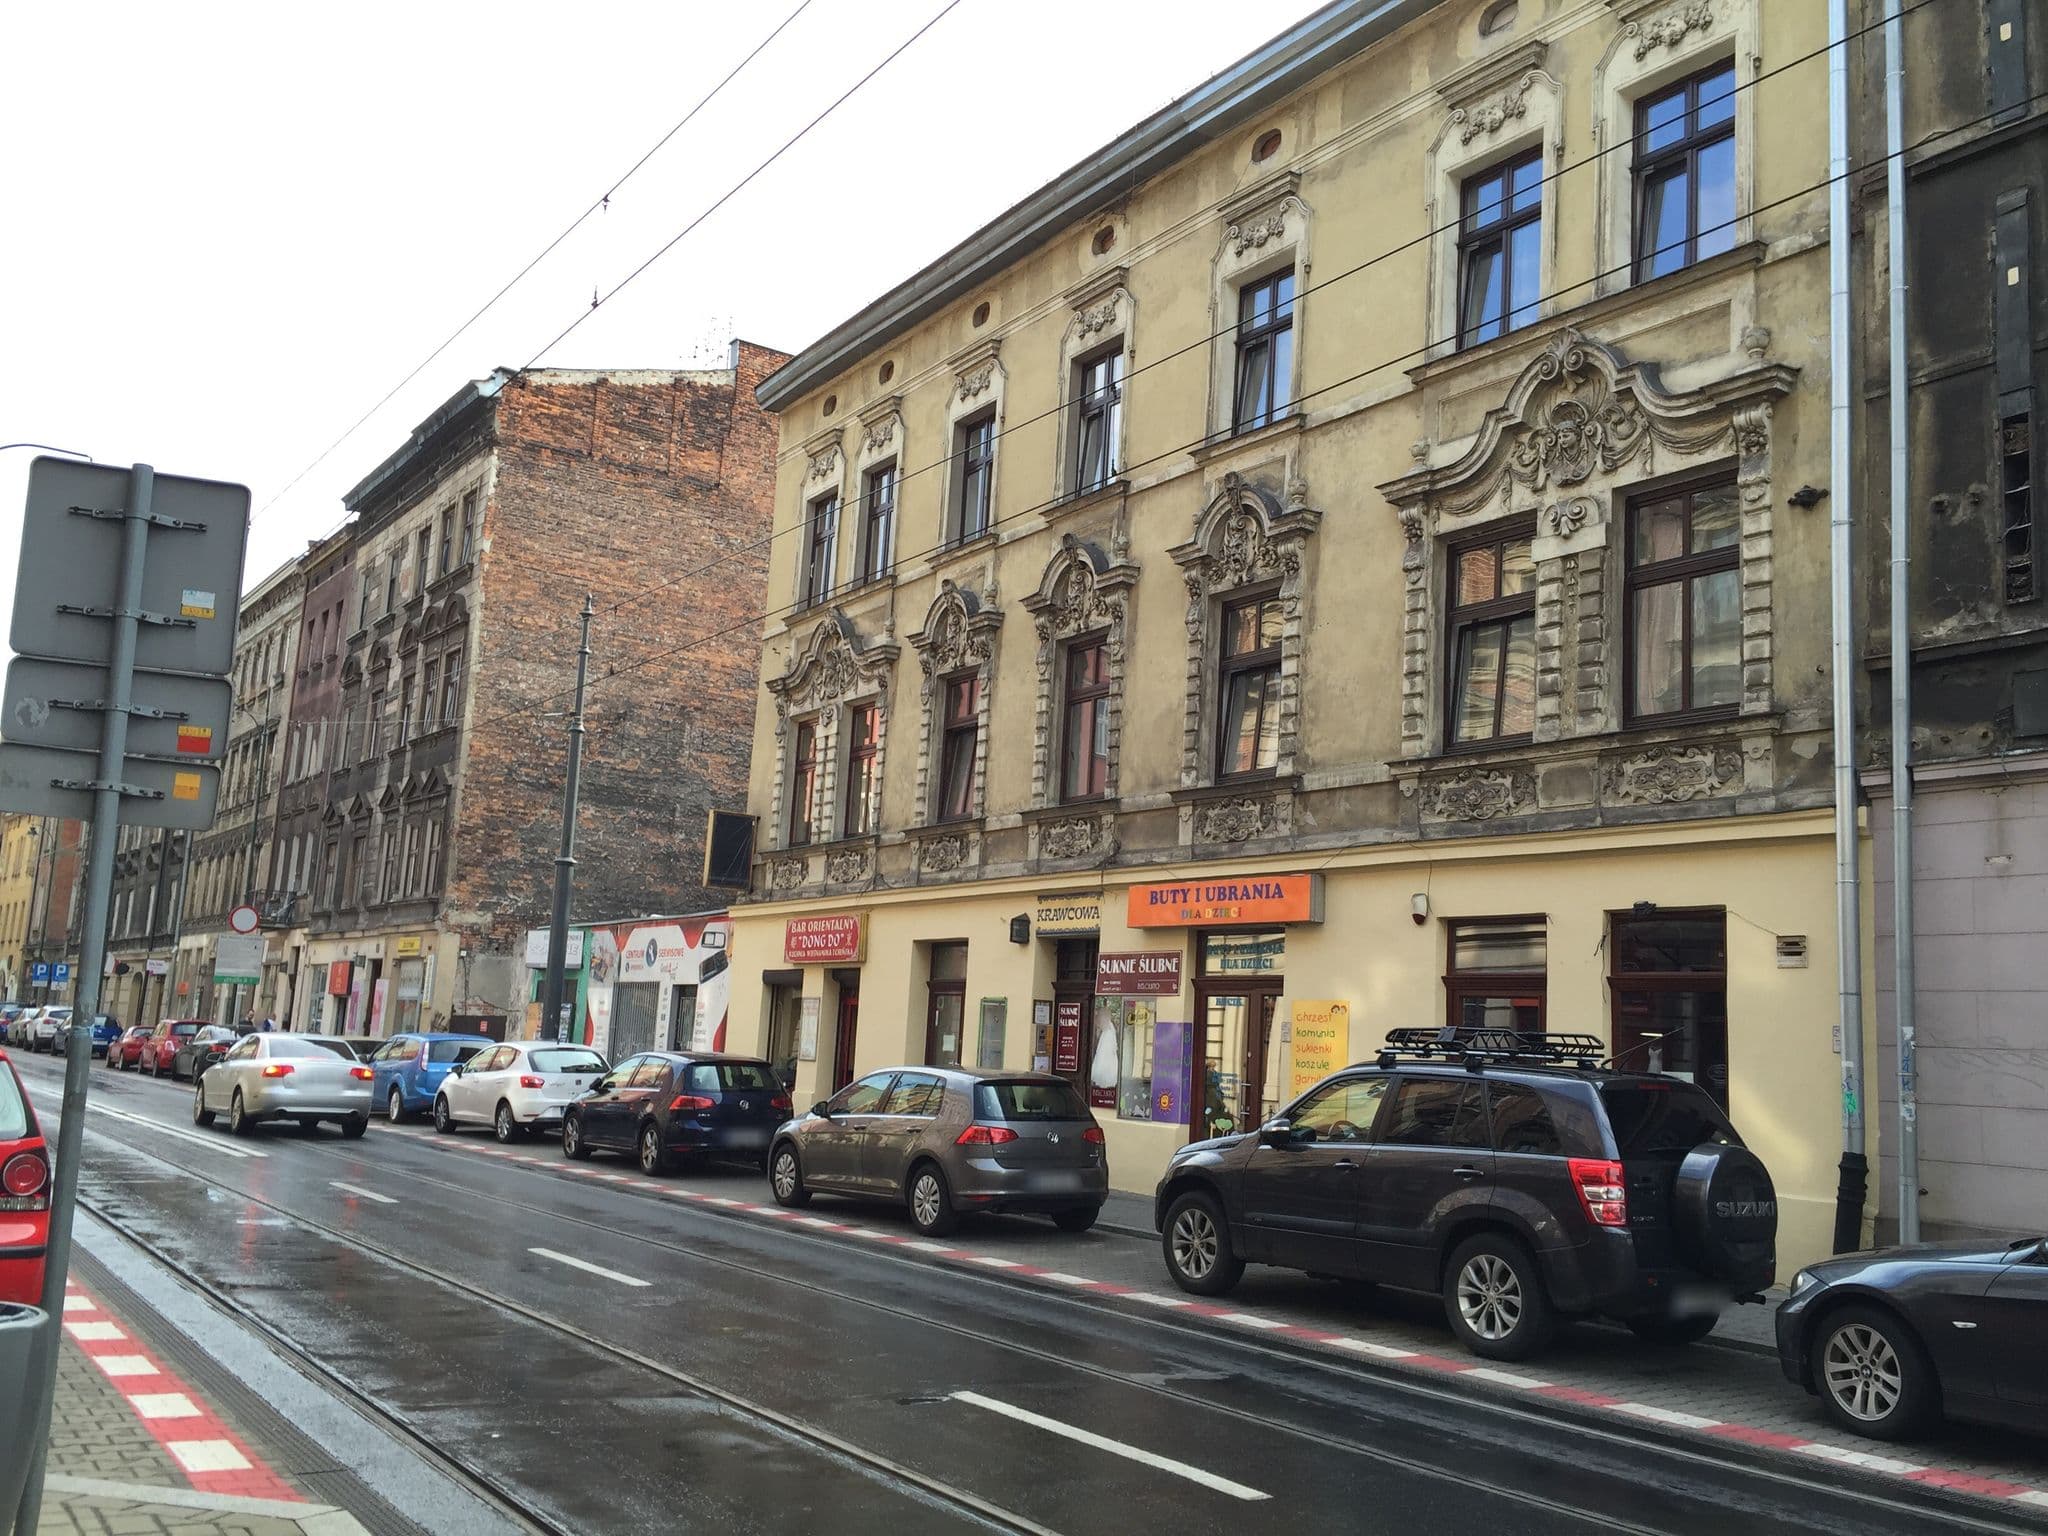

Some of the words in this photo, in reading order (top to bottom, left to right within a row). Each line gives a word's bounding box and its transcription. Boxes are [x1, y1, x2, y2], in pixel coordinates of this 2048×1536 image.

[1150, 888, 1191, 905] BUTY
[1195, 888, 1200, 902] I
[1205, 883, 1284, 901] UBRANIA
[1037, 906, 1100, 921] KRAWCOWA
[1181, 909, 1201, 919] DLA
[1205, 907, 1242, 919] DZIECI
[791, 921, 807, 933] BAR
[808, 918, 854, 932] ORIENTALNY
[1100, 959, 1136, 973] SUKNIE
[1138, 955, 1179, 973] ŚLUBNE
[37, 965, 46, 976] P
[56, 965, 66, 977] P
[1296, 1027, 1336, 1038] komunia
[1296, 1043, 1332, 1054] sukienki
[1295, 1058, 1329, 1070] koszule
[1716, 1201, 1776, 1217] SUZUKI
